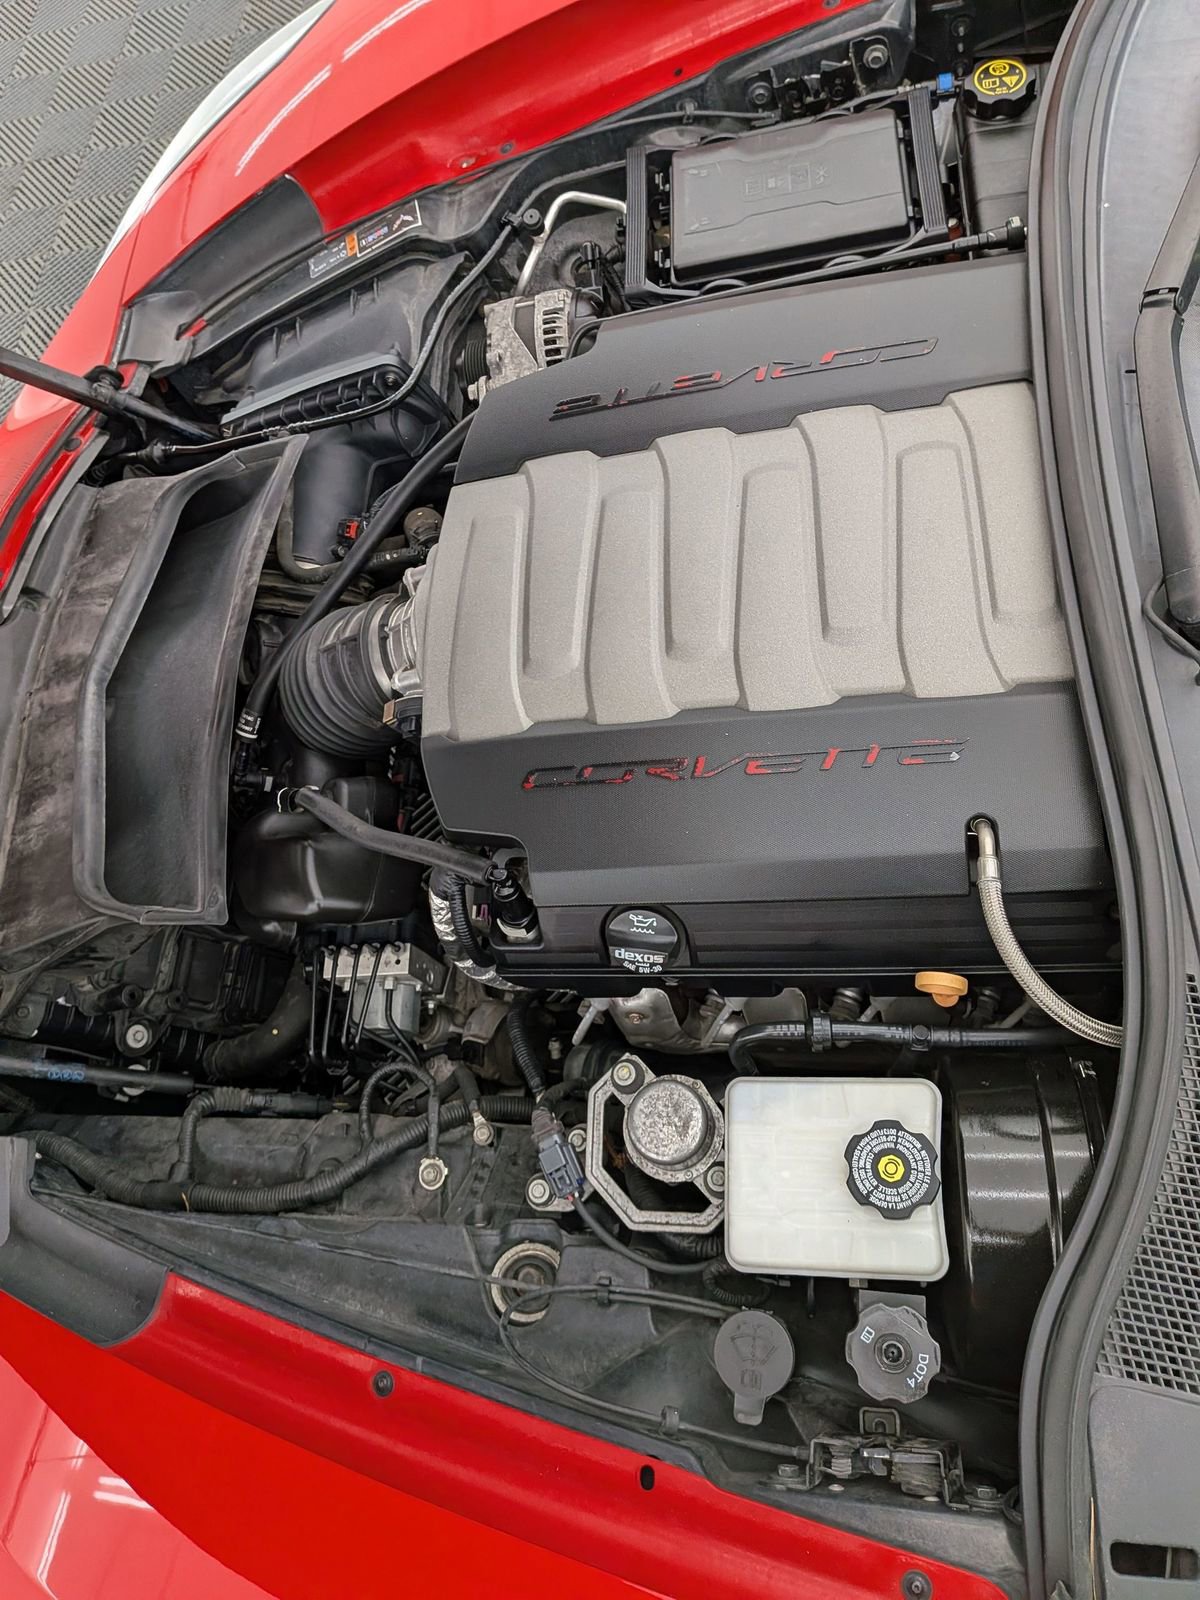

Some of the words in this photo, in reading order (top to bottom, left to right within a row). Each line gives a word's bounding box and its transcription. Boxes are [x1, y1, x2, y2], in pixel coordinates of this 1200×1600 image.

[548, 336, 939, 421] CORVETTE
[521, 737, 971, 791] CORVETTE
[615, 948, 664, 964] dexos
[622, 960, 637, 972] SAE
[858, 1134, 871, 1147] FROM
[868, 1134, 886, 1147] BEFORE
[869, 1128, 883, 1139] FLUID
[851, 1148, 861, 1166] SEALED
[864, 1152, 875, 1167] CLEAN
[920, 1148, 931, 1175] NETTOYER
[862, 1178, 873, 1192] ONLY
[865, 1169, 877, 1187] FILLER
[923, 1175, 931, 1183] LE
[897, 1181, 913, 1194] BIDON
[906, 1179, 923, 1197] LIQUIDE
[910, 1182, 929, 1203] BOUCHON
[885, 1194, 901, 1202] FREIN
[901, 1192, 908, 1200] DE
[896, 1198, 912, 1209] AVANT
[906, 1353, 929, 1388] DOT4
